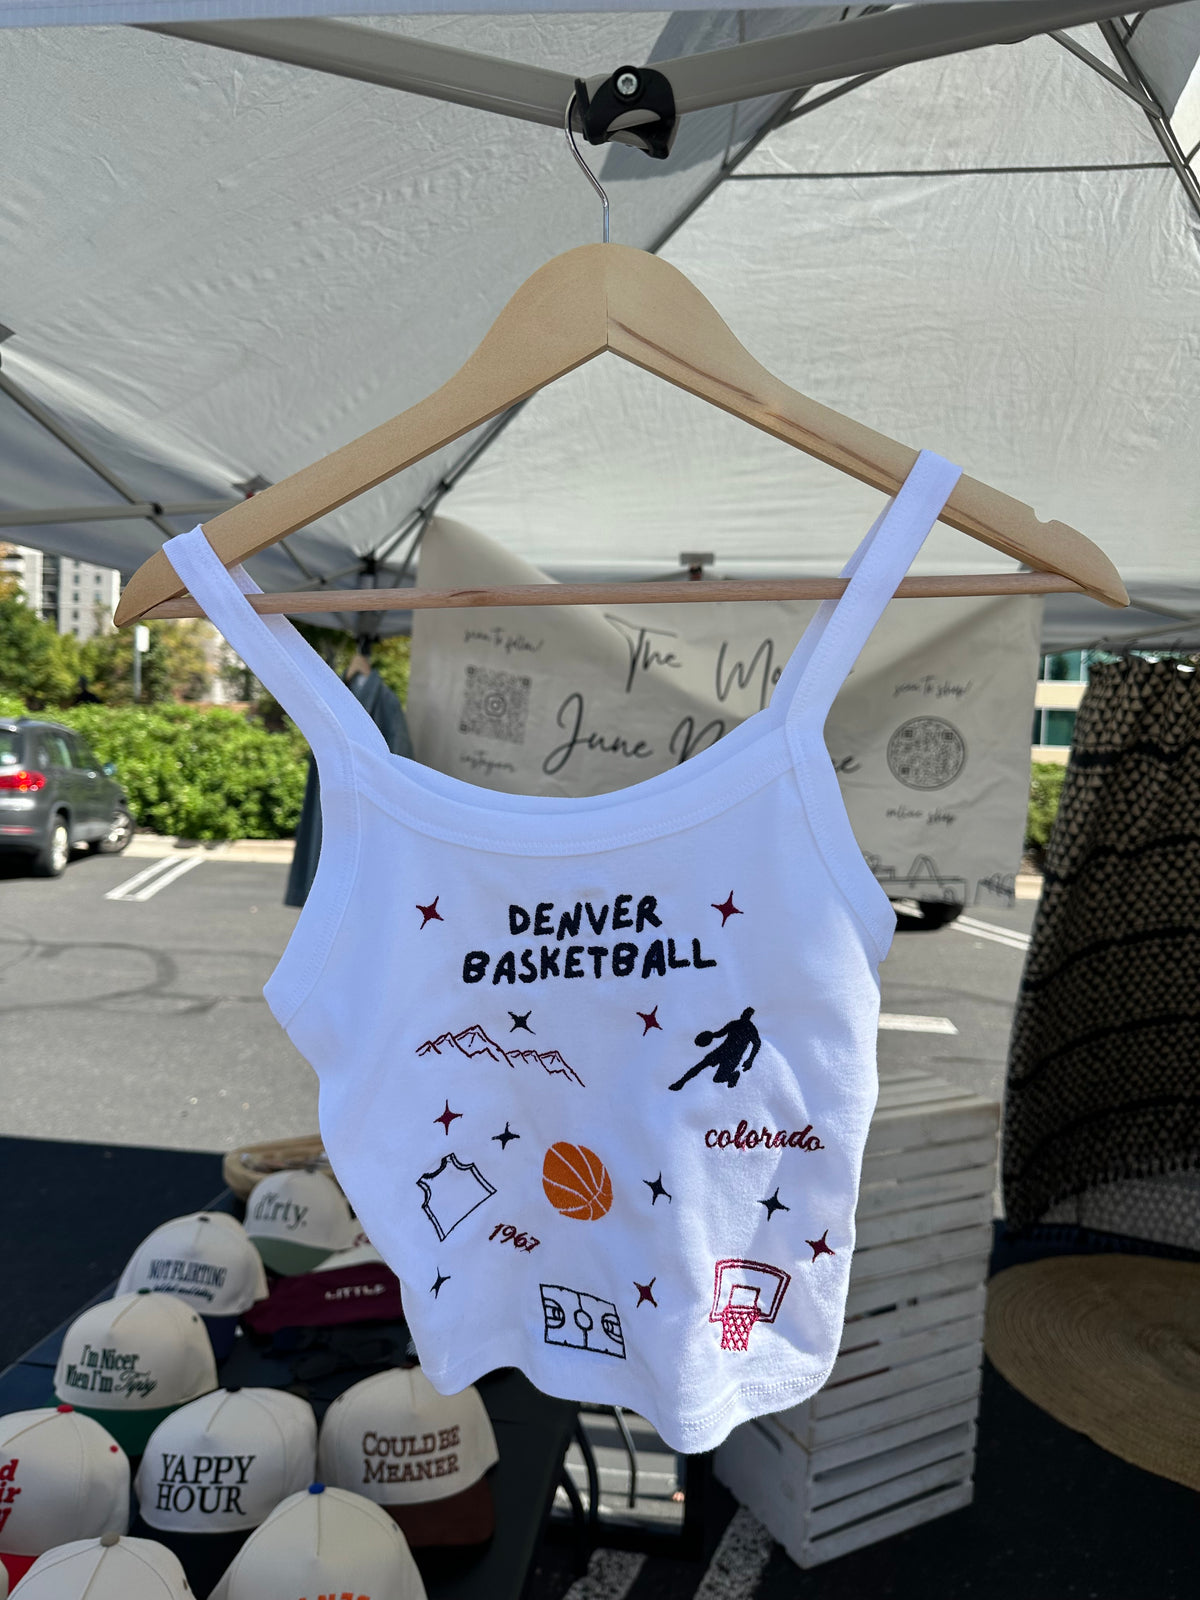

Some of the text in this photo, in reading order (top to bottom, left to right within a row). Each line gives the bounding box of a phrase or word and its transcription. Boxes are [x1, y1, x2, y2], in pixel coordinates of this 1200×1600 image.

[603, 613, 682, 694] The
[543, 692, 653, 775] June
[509, 894, 663, 941] DENVER
[462, 938, 717, 986] BASKETBALL
[705, 1119, 826, 1153] colorado
[488, 1222, 541, 1254] 1967
[148, 1259, 228, 1289] NOT FLIRTING
[324, 1283, 385, 1300] LITTLE
[80, 1344, 139, 1371] I'm Nicer
[65, 1364, 91, 1391] When
[90, 1370, 113, 1393] I'm
[362, 1424, 460, 1457] COULD BE
[161, 1453, 256, 1484] YAPPY
[362, 1452, 460, 1484] MEANER
[156, 1483, 248, 1515] HOUR
